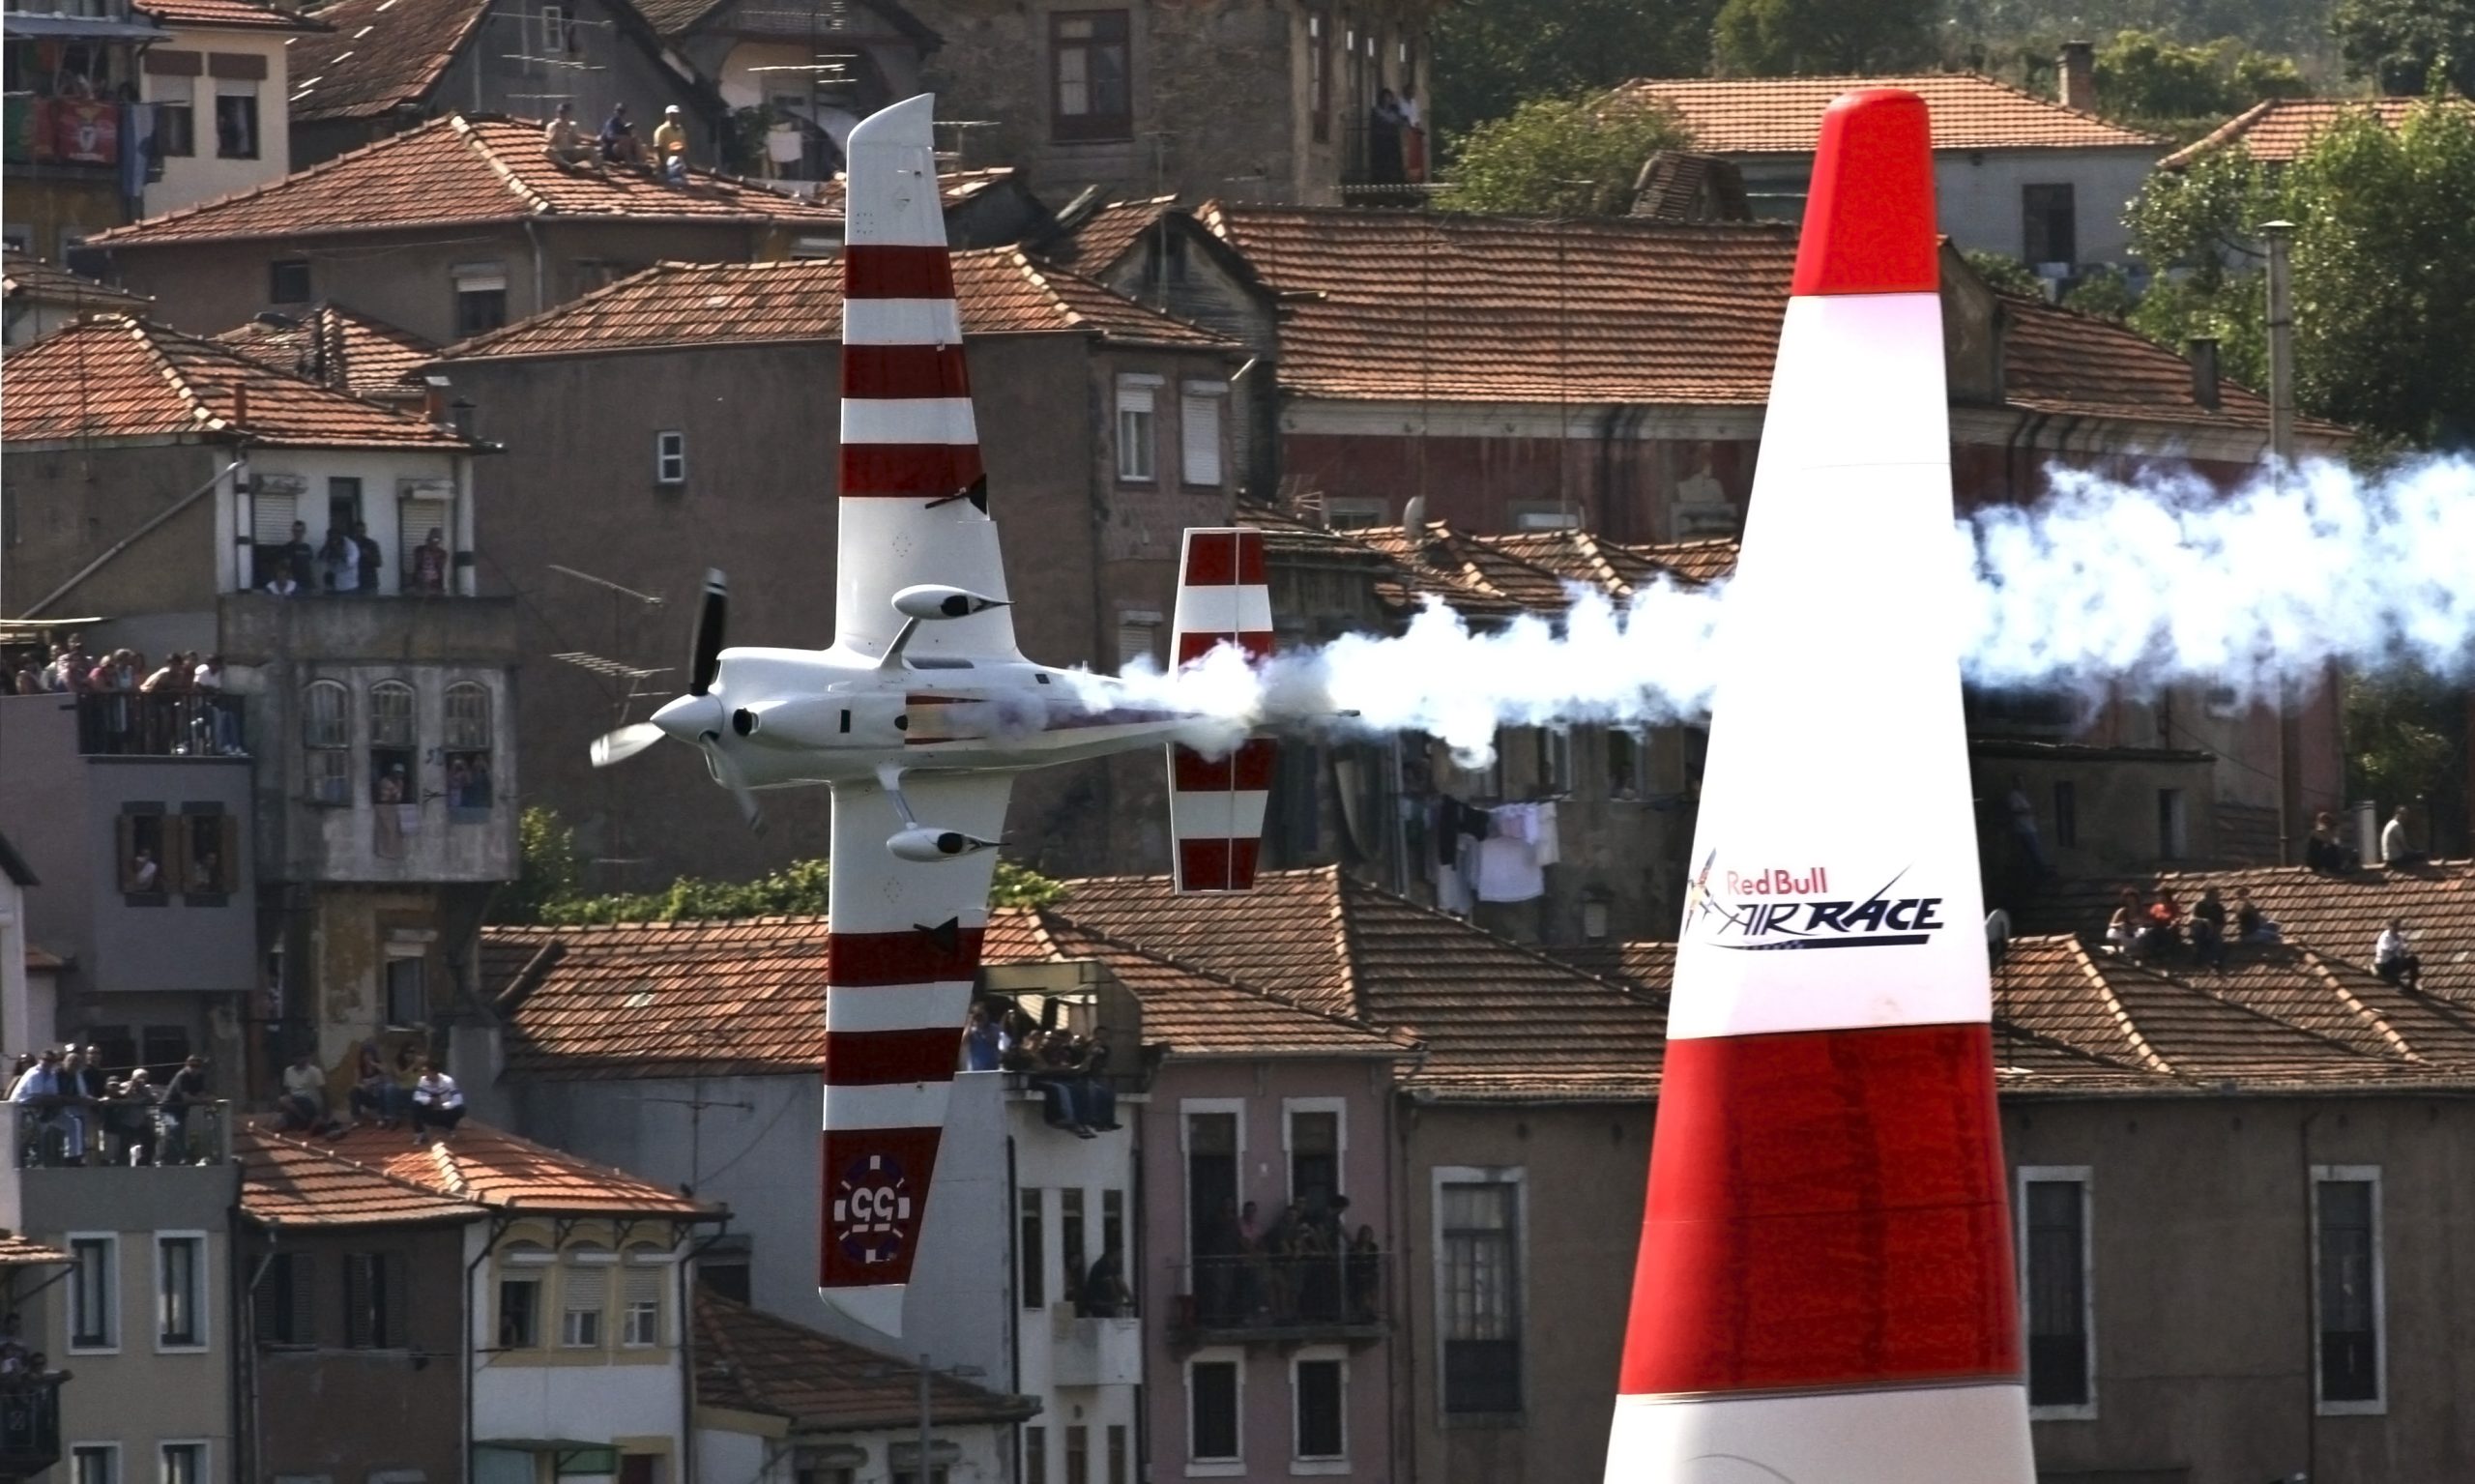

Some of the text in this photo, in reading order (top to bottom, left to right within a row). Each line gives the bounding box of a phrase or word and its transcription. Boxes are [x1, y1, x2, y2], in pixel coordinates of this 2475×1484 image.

[1727, 867, 1828, 895] Red Bull
[1717, 876, 1944, 935] AIR RACE
